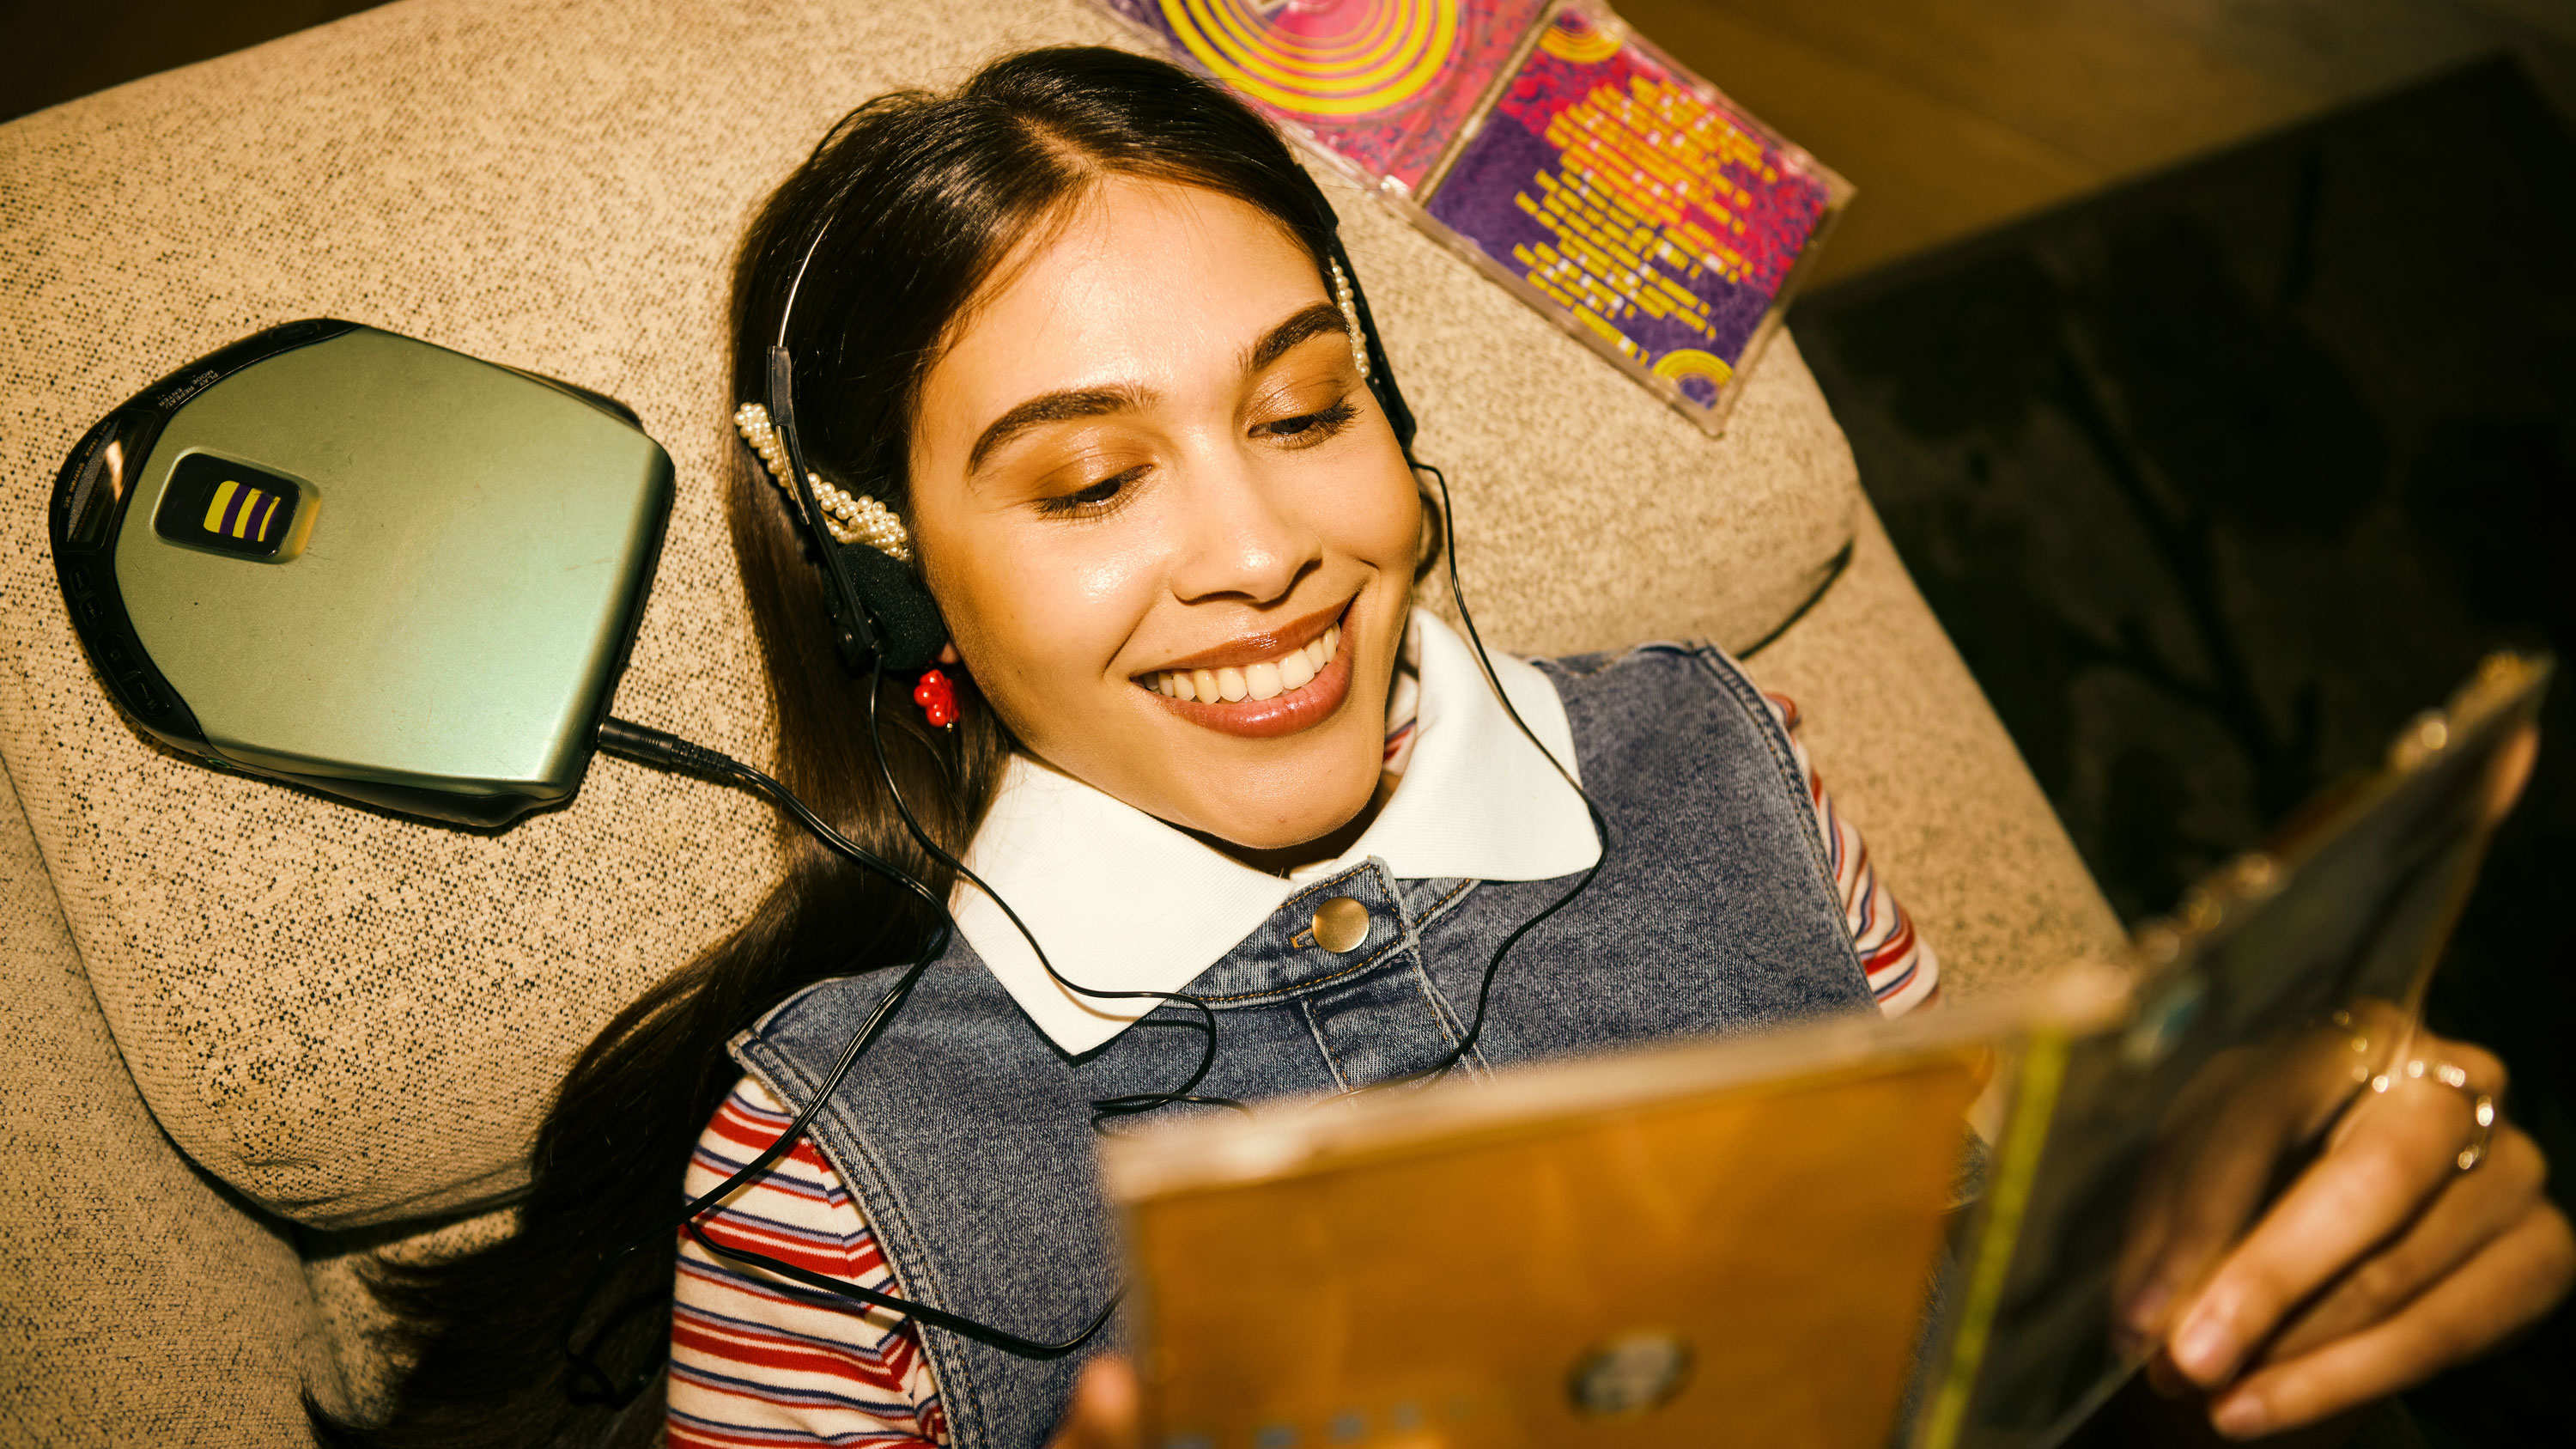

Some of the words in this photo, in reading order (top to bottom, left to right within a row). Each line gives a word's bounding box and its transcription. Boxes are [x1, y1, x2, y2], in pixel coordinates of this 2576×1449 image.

[191, 369, 214, 385] MODE
[199, 372, 219, 387] PLAY
[158, 387, 183, 407] ENTER
